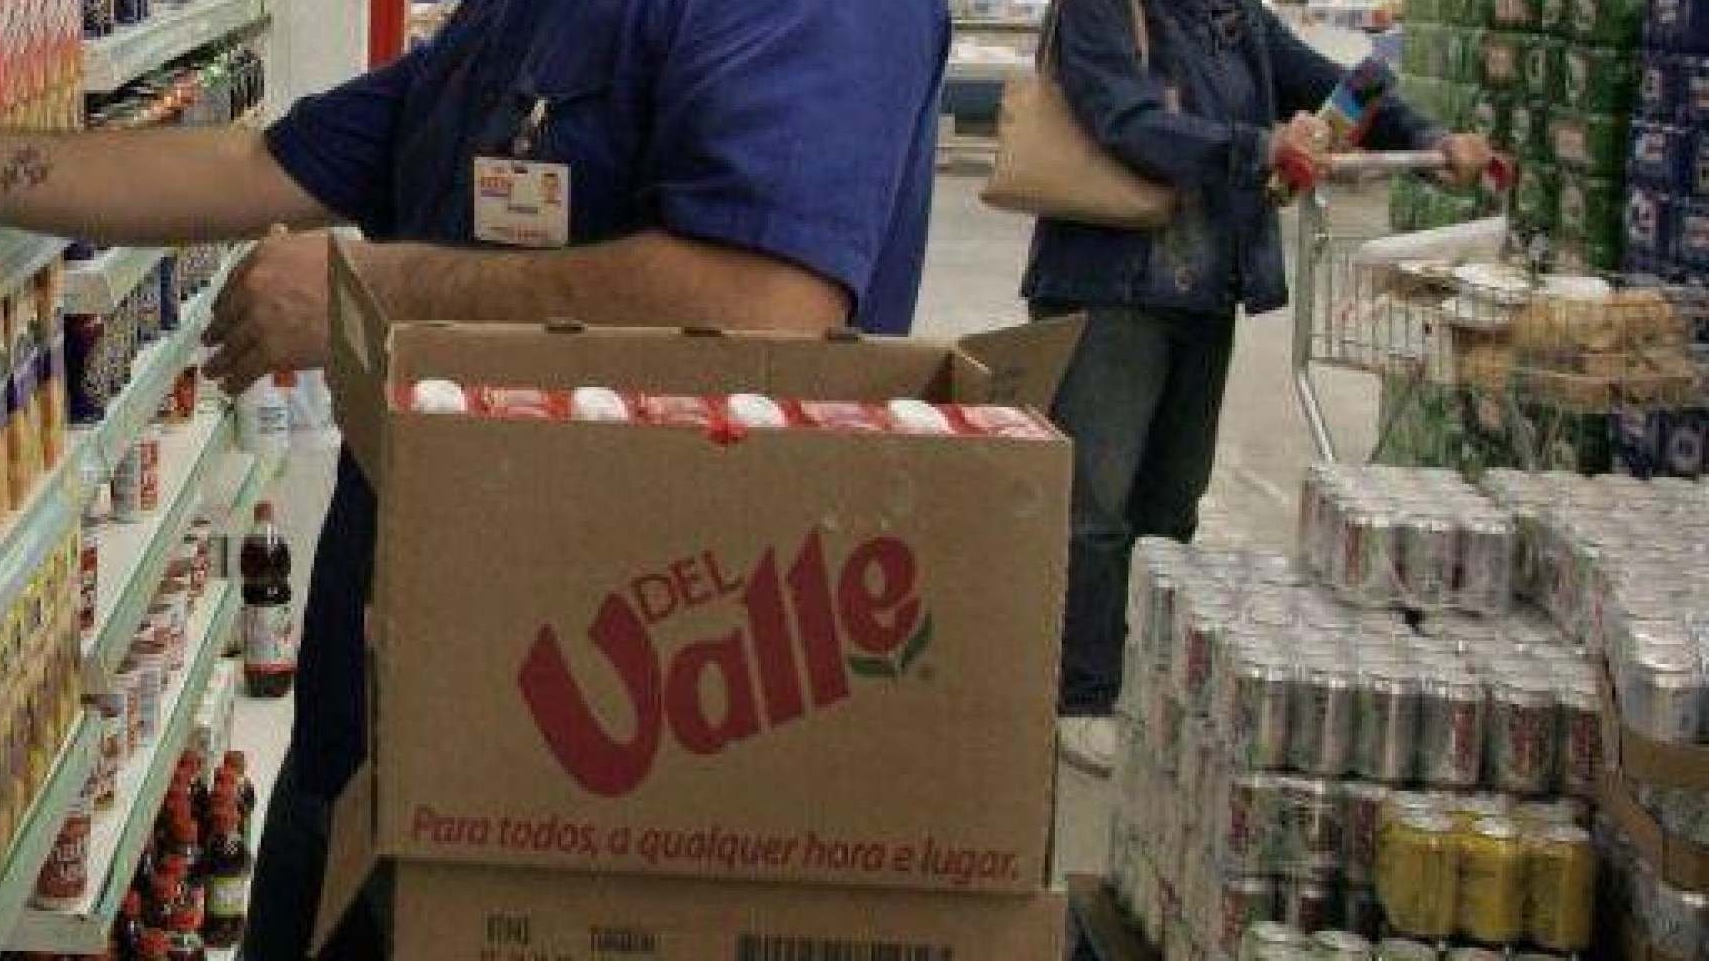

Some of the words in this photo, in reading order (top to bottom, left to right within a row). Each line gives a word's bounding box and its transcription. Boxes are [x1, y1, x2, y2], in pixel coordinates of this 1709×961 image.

[631, 549, 748, 625] DEL
[517, 527, 922, 800] Valle
[412, 805, 490, 846] Para
[499, 813, 598, 857] todos,
[607, 828, 630, 856] a
[637, 824, 797, 869] qualquer
[807, 830, 883, 873] hora
[891, 845, 912, 871] e
[920, 837, 1021, 888] lugar.
